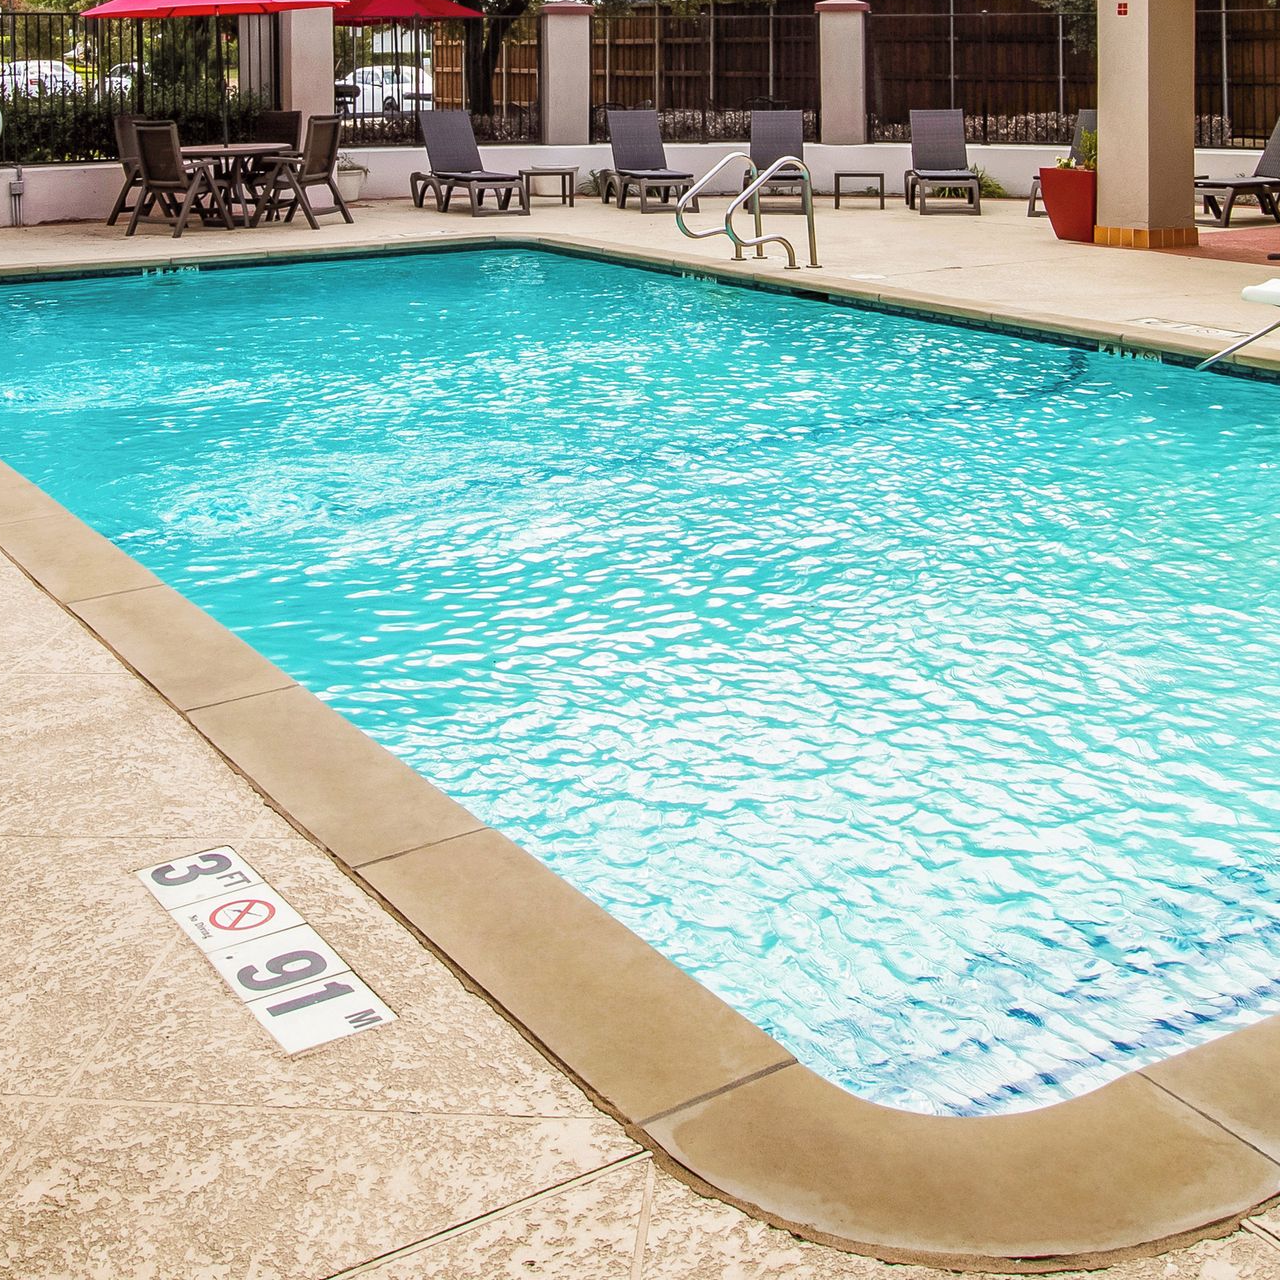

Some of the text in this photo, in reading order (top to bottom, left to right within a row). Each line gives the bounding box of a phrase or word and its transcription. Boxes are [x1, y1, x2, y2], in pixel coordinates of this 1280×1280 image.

[151, 853, 252, 888] 3 FT
[195, 921, 213, 940] Diving
[344, 1008, 383, 1029] M
